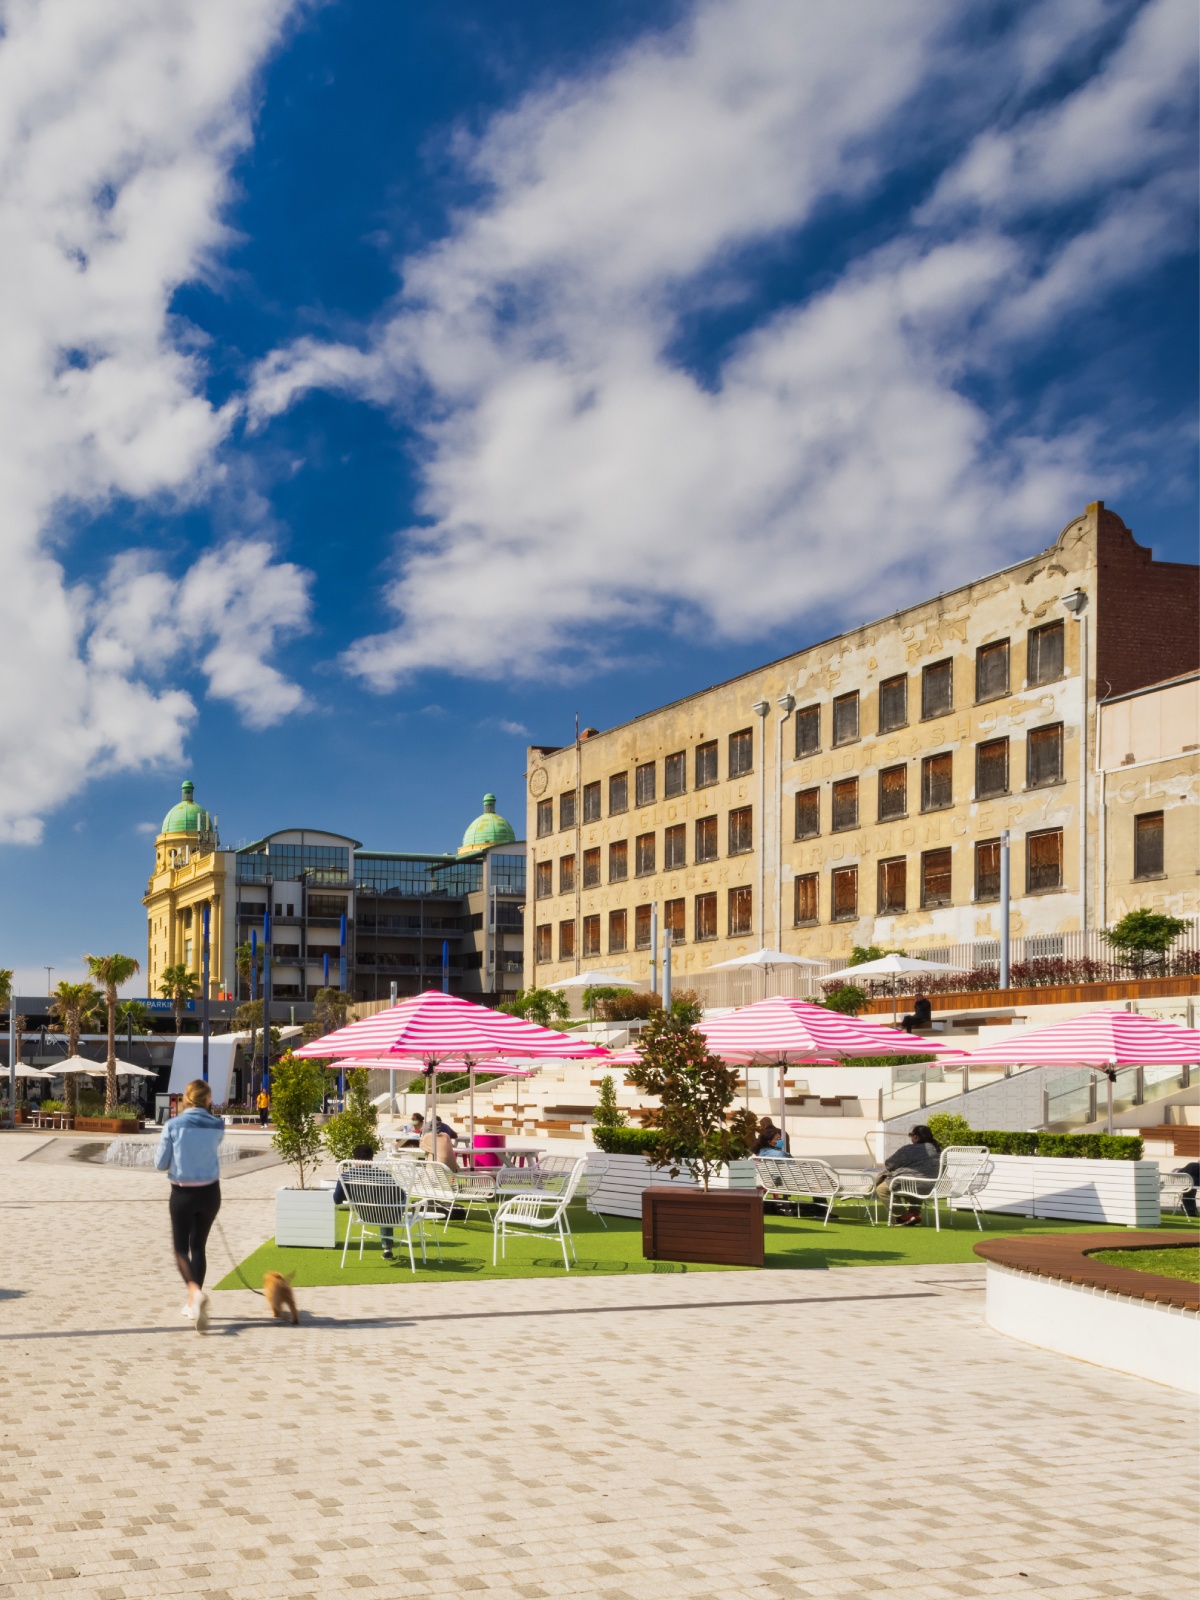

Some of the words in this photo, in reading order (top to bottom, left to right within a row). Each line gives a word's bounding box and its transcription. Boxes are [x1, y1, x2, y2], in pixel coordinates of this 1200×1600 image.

[827, 616, 968, 691] PARAN
[800, 739, 901, 785] BOOTS
[930, 692, 1055, 747] SHOES
[640, 784, 749, 829] CLOTHING
[540, 887, 624, 920] HOSERY
[640, 860, 748, 899] GROCERY
[146, 1001, 174, 1009] PARKIN
